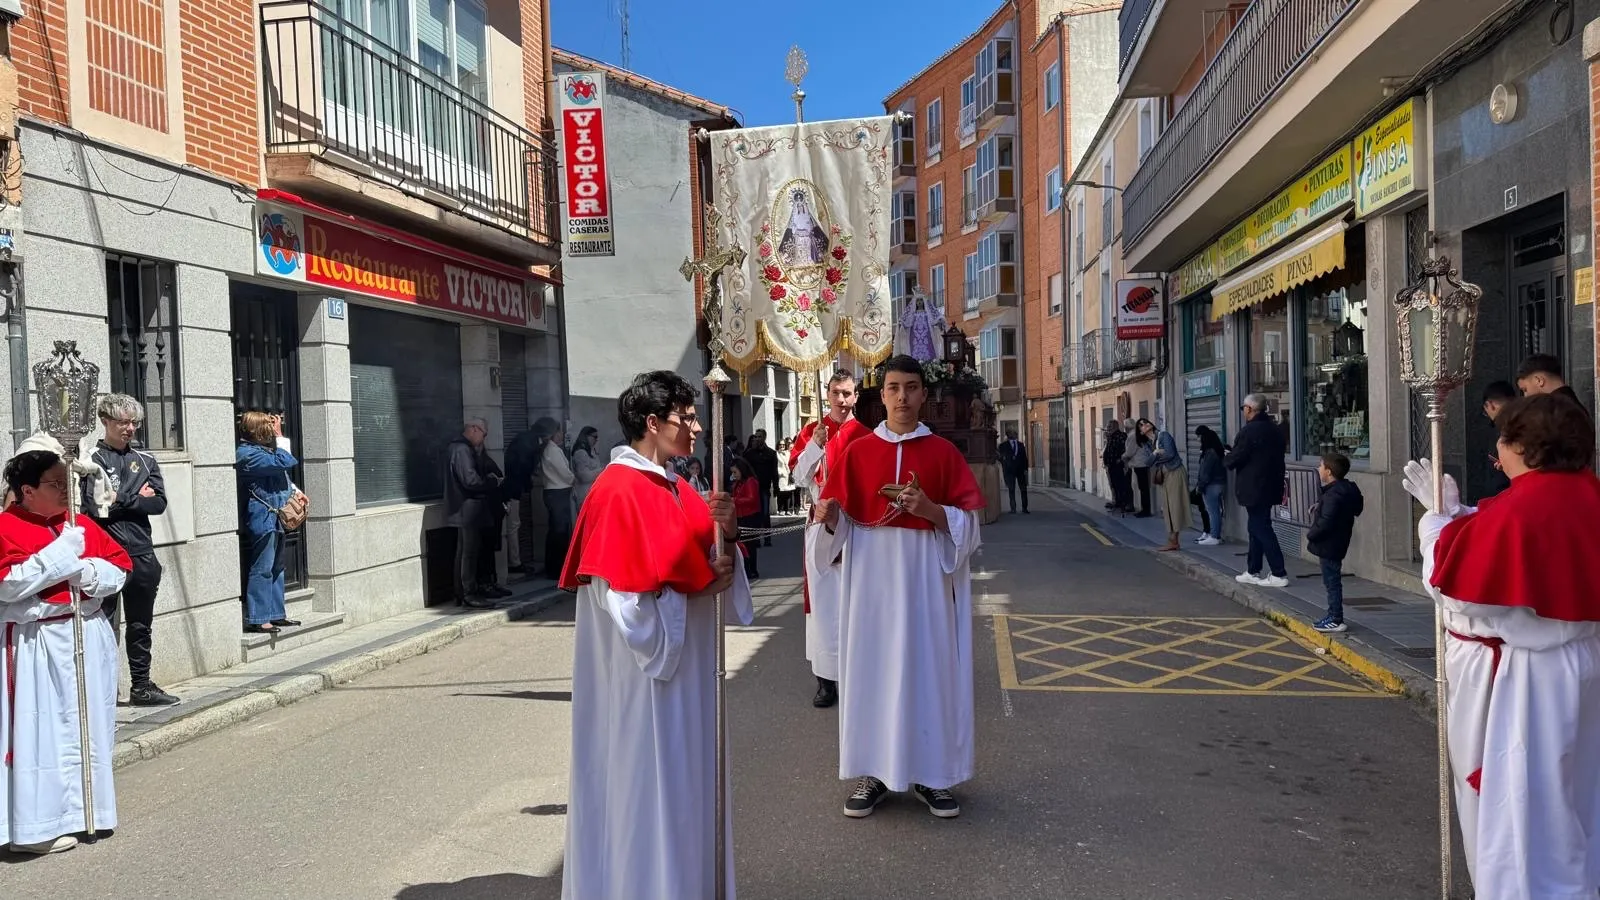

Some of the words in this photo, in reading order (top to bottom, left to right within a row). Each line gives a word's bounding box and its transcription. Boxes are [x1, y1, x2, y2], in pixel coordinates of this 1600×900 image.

[570, 111, 602, 214] VICTOR
[1309, 154, 1344, 193] PINTURAS
[1365, 136, 1408, 186] PINSA
[1309, 179, 1349, 217] BRICOLAGE
[1509, 192, 1513, 204] 5
[569, 218, 609, 227] COMIDAS
[569, 226, 609, 234] CASERAS
[569, 240, 612, 254] RESTAURANTE
[308, 224, 440, 300] Restaurante
[443, 263, 525, 320] VICTOR
[1229, 273, 1274, 307] ESPECIALIDADES
[1287, 253, 1312, 281] PINSA
[332, 300, 342, 315] 16
